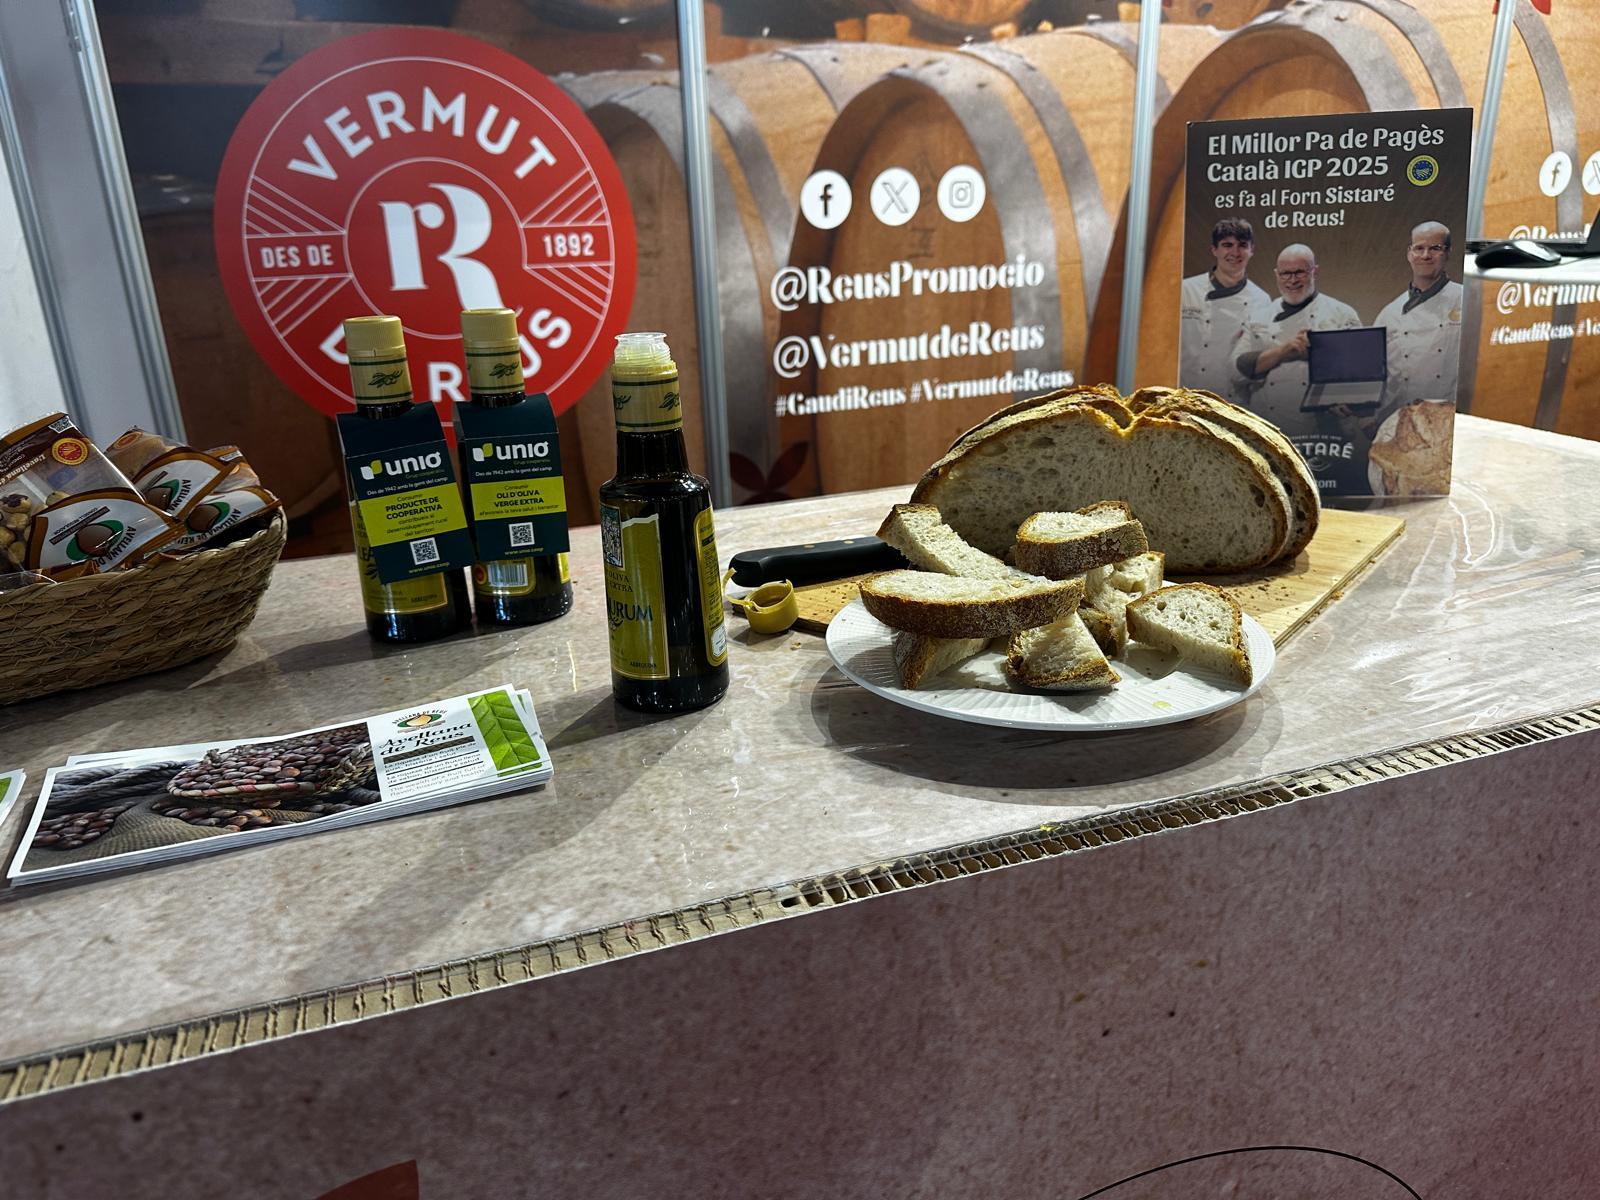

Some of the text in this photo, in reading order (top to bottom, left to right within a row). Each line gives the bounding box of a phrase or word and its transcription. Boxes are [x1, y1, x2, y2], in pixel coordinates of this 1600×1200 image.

[286, 86, 558, 181] VERMUT
[1208, 123, 1445, 156] El Millor Pa de Pagès
[1206, 155, 1389, 183] Català IGP 2025
[1215, 183, 1395, 208] es fa al Forn Sistaré
[1264, 209, 1345, 229] de Reus!
[261, 244, 334, 269] DES DE
[543, 233, 595, 258] 1892
[770, 254, 1045, 312] @ReusPromocio
[773, 321, 1045, 378] @VermutdeReus
[775, 368, 1075, 417] #GaudiReus #VermutdeReus
[385, 496, 439, 512] PRODUCTE DE
[386, 504, 442, 520] COOPERATIVA
[520, 498, 544, 506] EXTRA
[107, 526, 137, 562] AVELLANA
[379, 723, 472, 749] Avellana
[380, 732, 464, 756] de Reus
